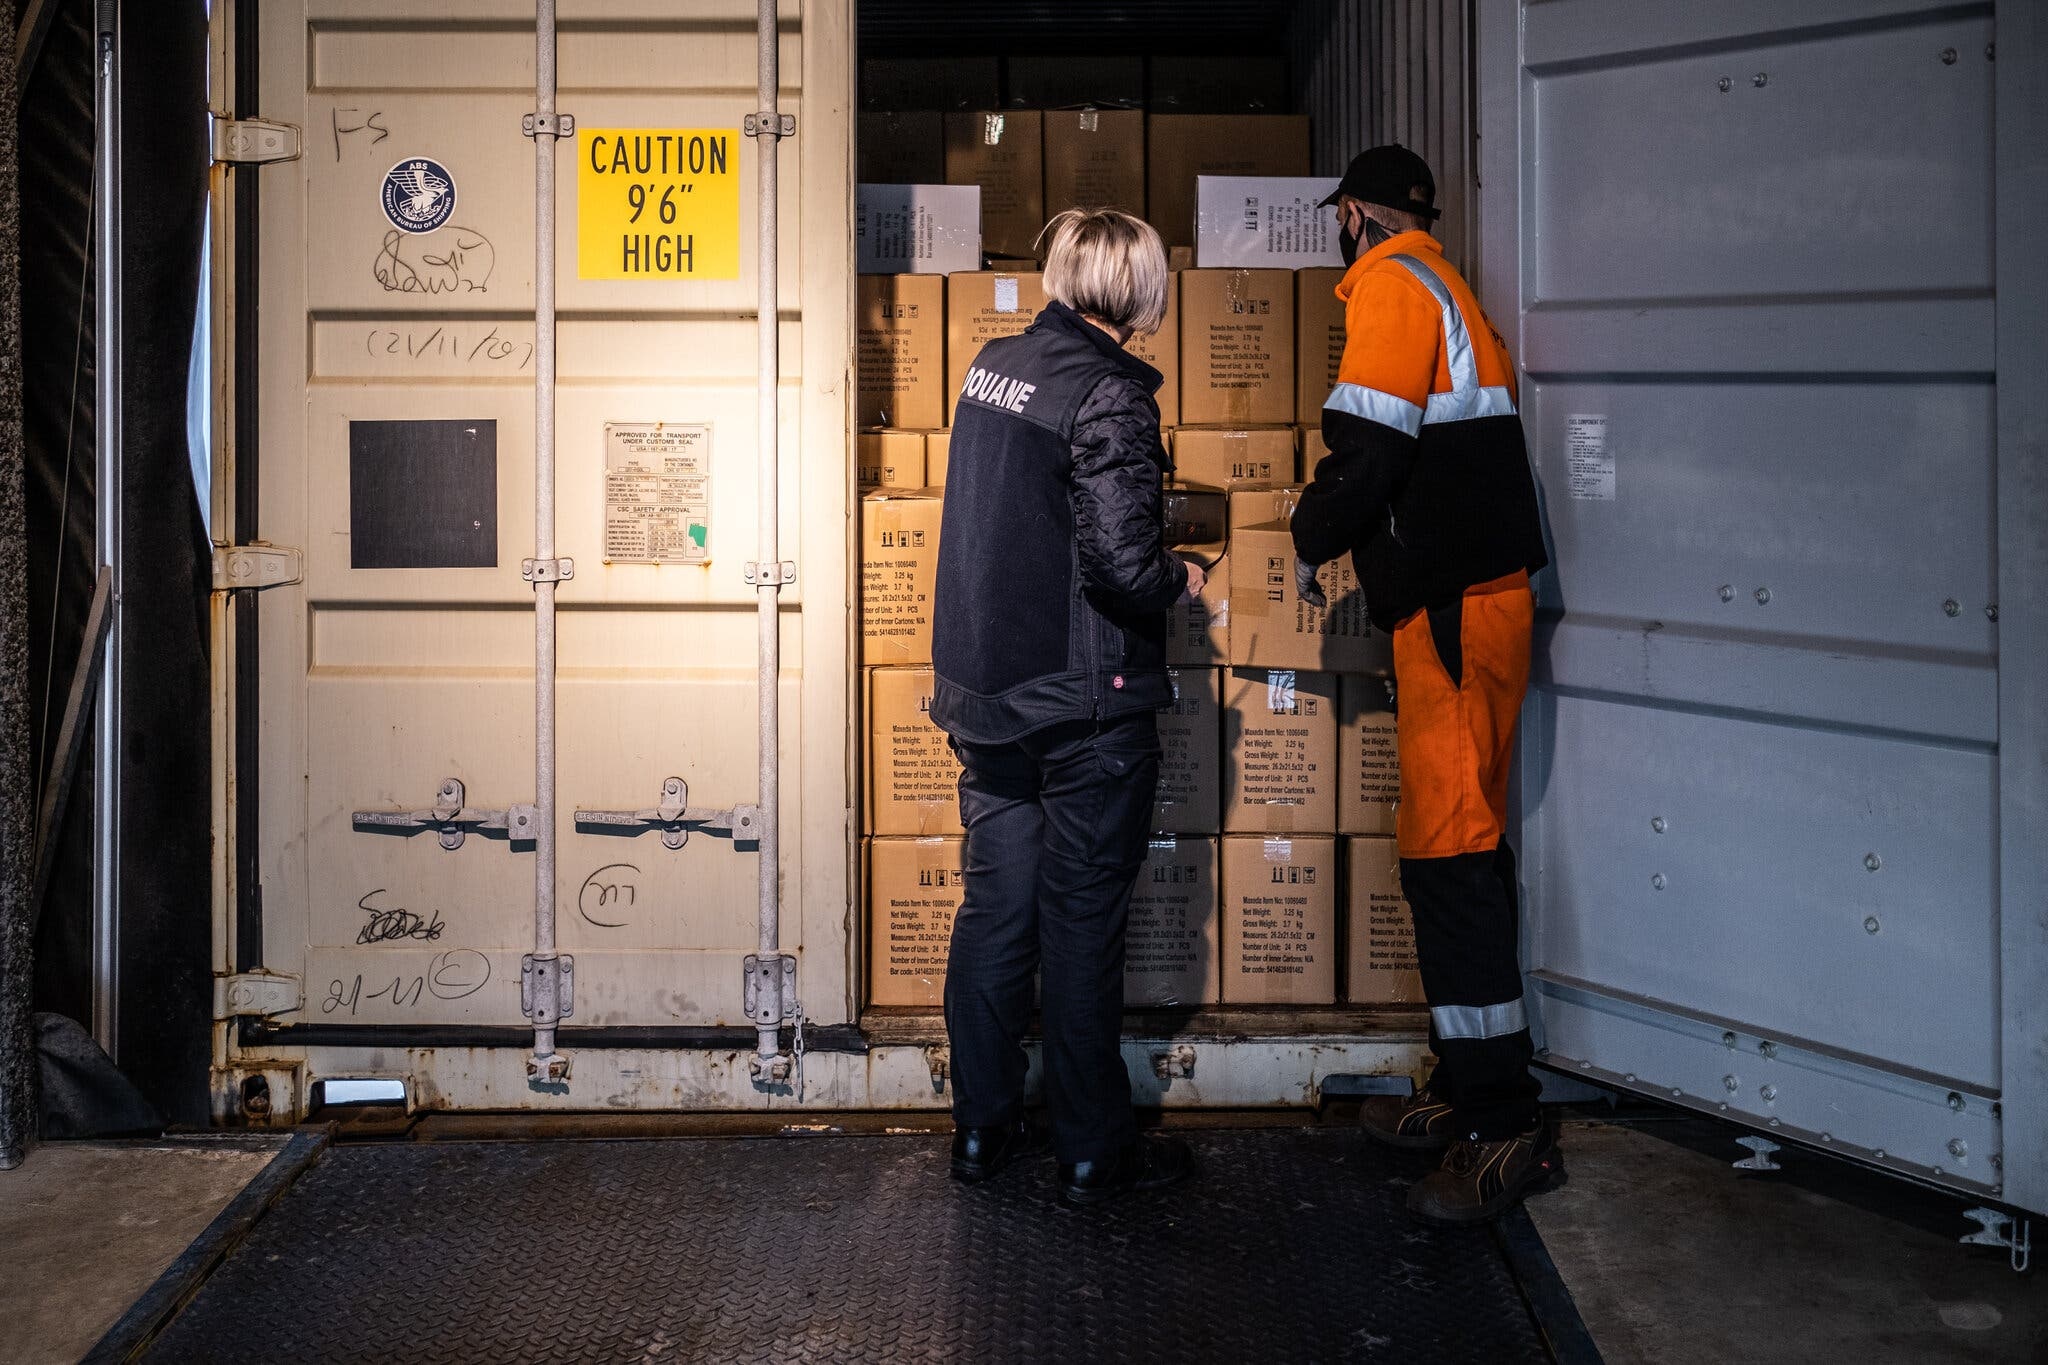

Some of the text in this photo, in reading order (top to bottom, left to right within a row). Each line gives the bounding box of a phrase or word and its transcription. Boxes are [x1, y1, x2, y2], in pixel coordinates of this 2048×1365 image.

[591, 136, 726, 174] CAUTION
[409, 162, 428, 170] ABS
[385, 184, 397, 218] AMERICAN
[397, 216, 422, 229] BUREAU
[433, 197, 452, 224] SHIPPING
[628, 184, 693, 224] 9'6"
[623, 234, 693, 272] HIGH
[1330, 561, 1338, 570] CM
[907, 572, 913, 581] kg
[1342, 570, 1350, 581] PCS
[907, 584, 913, 592] kg
[1298, 741, 1304, 750] kg
[946, 748, 952, 757] kg
[1245, 751, 1259, 759] Gross
[1298, 752, 1304, 761] kg
[1308, 763, 1316, 771] CM
[893, 771, 913, 779] Number
[913, 771, 919, 779] of
[935, 771, 941, 779] 24
[946, 771, 957, 779] PCS
[1245, 774, 1264, 782] Number
[1264, 774, 1270, 782] of
[1286, 774, 1292, 782] 24
[1298, 775, 1309, 783] PCS
[893, 782, 913, 790] Number
[914, 782, 919, 790] of
[944, 912, 950, 920] kg
[1296, 909, 1303, 918] kg
[891, 922, 950, 931] Gross kg
[1296, 920, 1303, 930] kg
[1306, 932, 1315, 940] CM
[1296, 943, 1307, 951] PCS
[891, 956, 916, 964] Number of
[1242, 954, 1262, 962] Number
[1263, 954, 1268, 962] of
[1242, 965, 1251, 973] Bar
